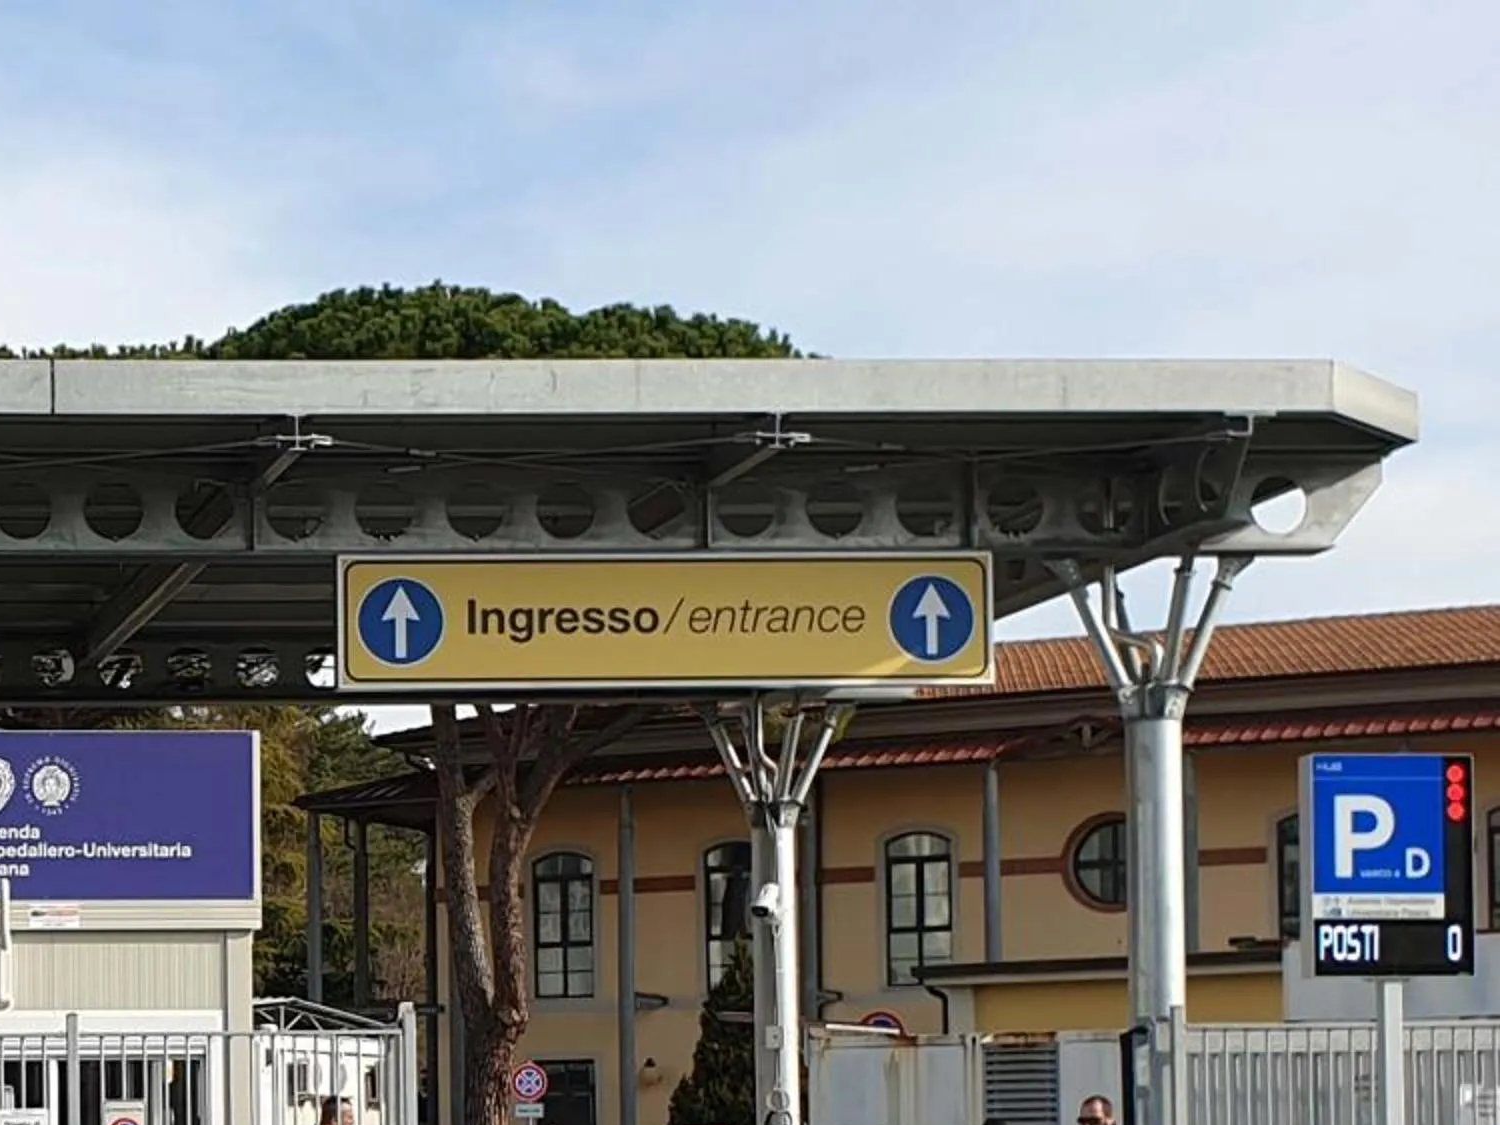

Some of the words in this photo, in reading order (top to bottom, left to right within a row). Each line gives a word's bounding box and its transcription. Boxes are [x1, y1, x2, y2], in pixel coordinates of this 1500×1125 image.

[1333, 794, 1396, 878] P
[1405, 847, 1431, 879] D
[1319, 924, 1380, 961] POSTI
[1447, 924, 1463, 962] 0
